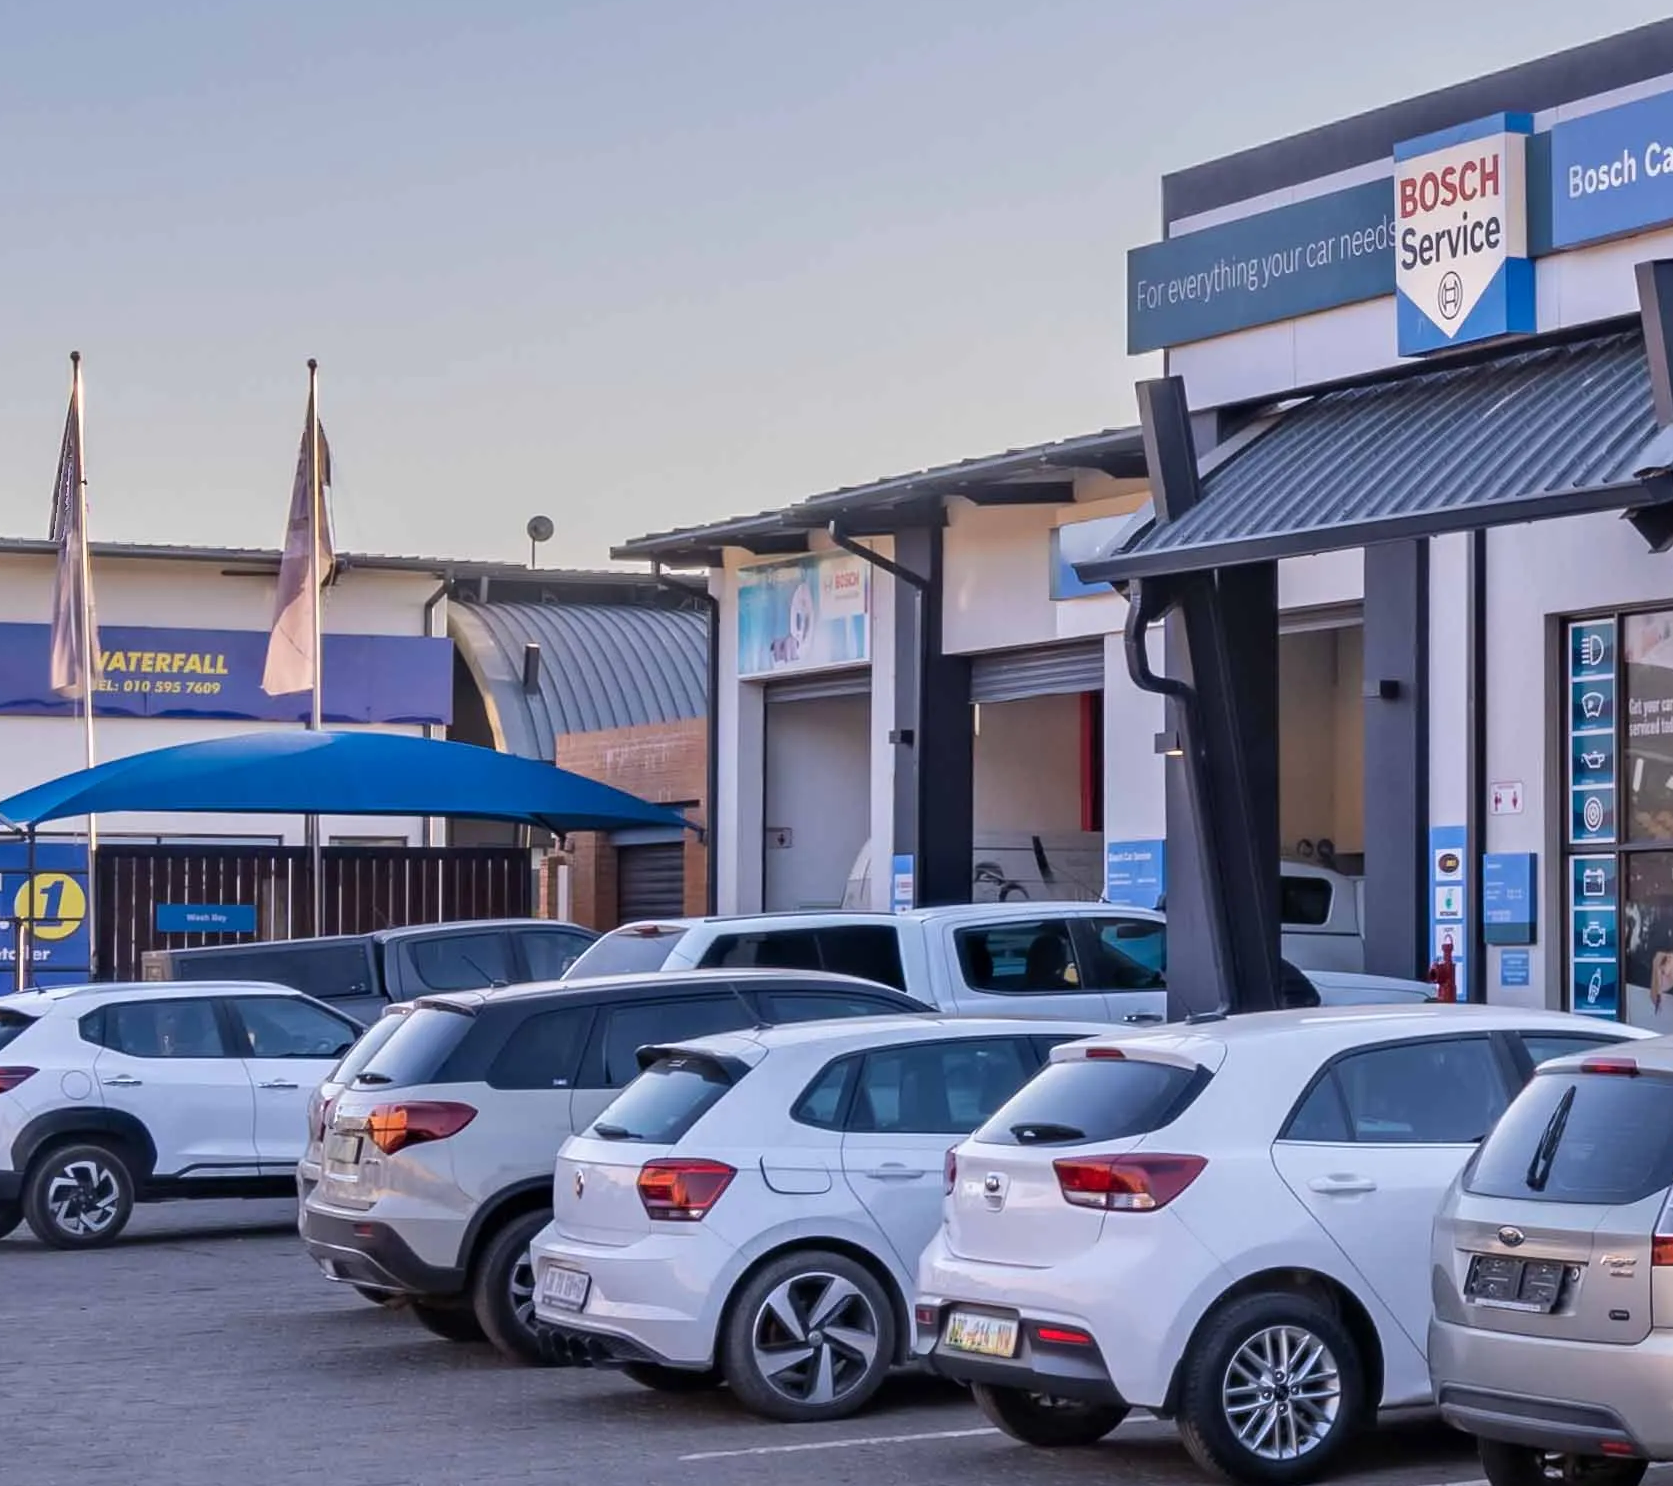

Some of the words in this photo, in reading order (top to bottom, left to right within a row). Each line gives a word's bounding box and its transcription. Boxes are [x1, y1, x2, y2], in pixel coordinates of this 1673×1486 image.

[1400, 154, 1499, 219] BOSCH
[1569, 150, 1636, 199] Bosch
[1137, 280, 1165, 311] For
[1168, 256, 1258, 302] everything
[1262, 246, 1302, 288] your
[1306, 235, 1336, 268] car
[1340, 215, 1396, 259] needs
[1401, 211, 1500, 270] Service
[124, 680, 150, 692] 010
[155, 680, 181, 693] 595
[186, 681, 221, 694] 7609
[1643, 699, 1660, 717] your
[1629, 716, 1659, 737] serviced
[35, 880, 65, 927] 1
